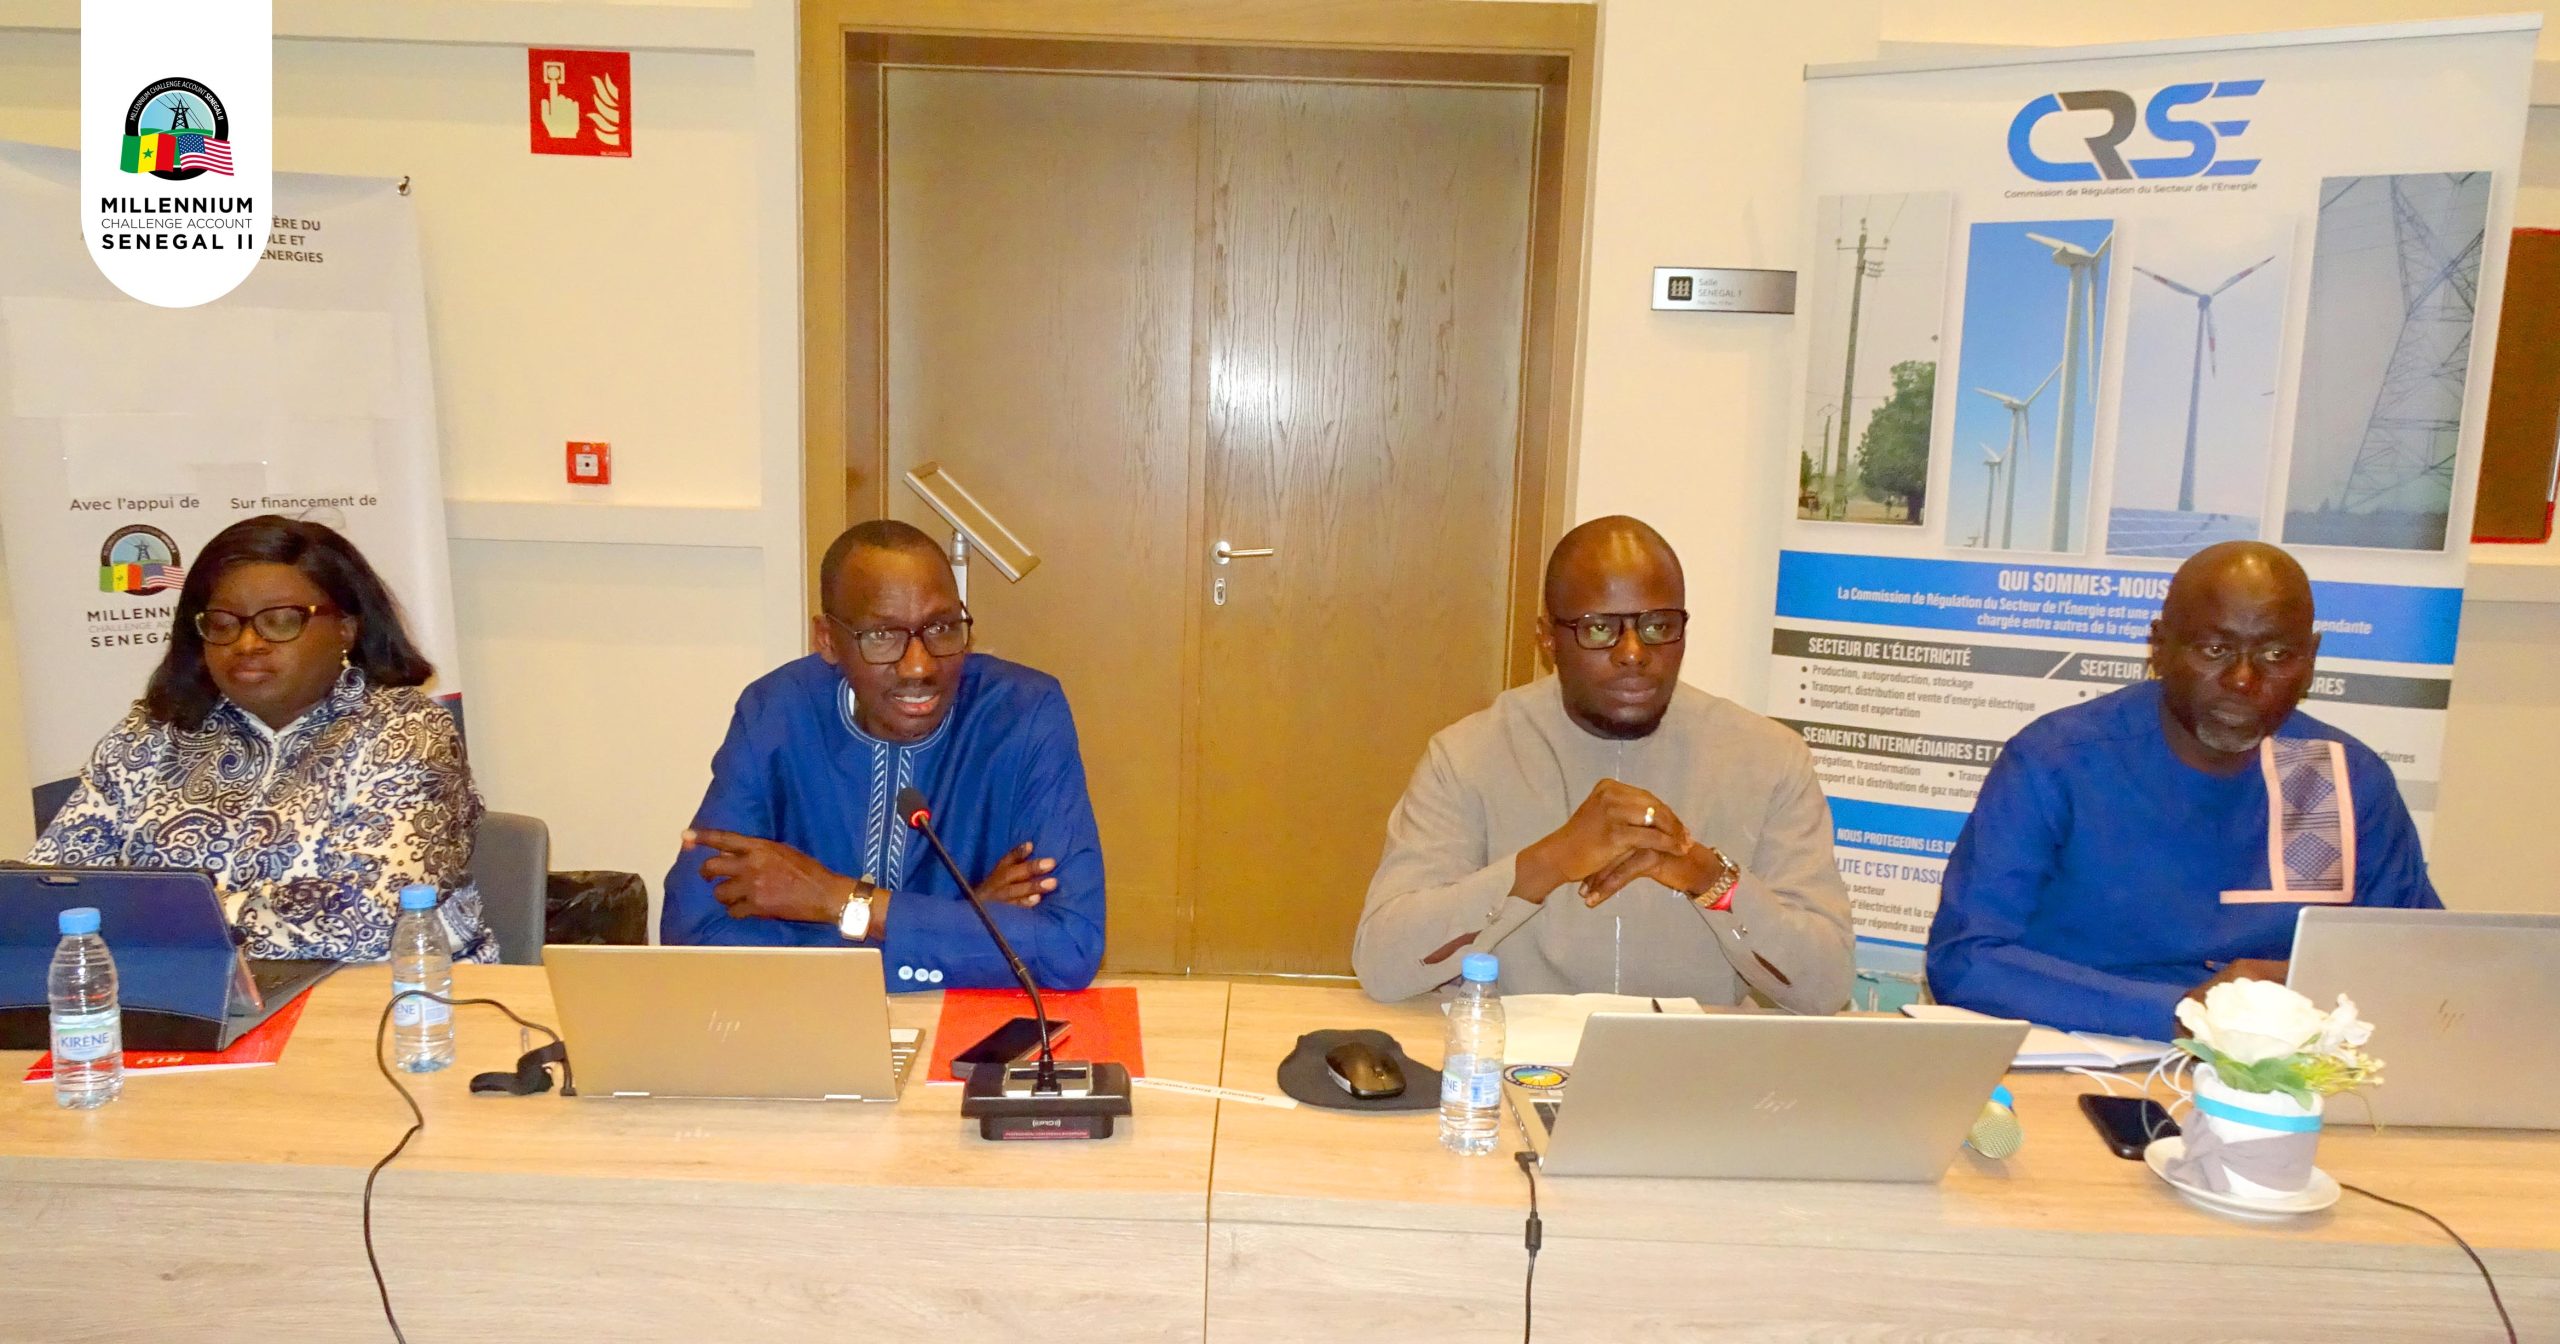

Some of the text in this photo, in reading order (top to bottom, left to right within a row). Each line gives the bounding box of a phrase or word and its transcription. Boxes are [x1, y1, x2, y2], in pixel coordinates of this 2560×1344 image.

[2007, 79, 2266, 183] CRSE
[2004, 188, 2063, 199] Commission
[2065, 187, 2079, 196] de
[2137, 185, 2151, 195] du
[2153, 183, 2193, 194] Secteur
[2195, 182, 2209, 192] de
[301, 219, 321, 231] DU
[267, 233, 305, 246] LE ET
[70, 496, 200, 511] Avec l'appui de
[231, 494, 377, 509] Sur financement de
[1998, 569, 2171, 600] QUI SOMMES-NOUS
[1837, 586, 1850, 600] La
[1850, 587, 1911, 604] Commission
[1912, 592, 1925, 605] de
[1926, 592, 1982, 609] Régulation
[1983, 597, 1998, 610] du
[2000, 597, 2041, 613] Secteur
[2042, 600, 2057, 614] de
[2107, 606, 2126, 618] est
[2127, 608, 2150, 619] une
[1977, 613, 2152, 640] chargée entre autres de la régul
[2312, 619, 2373, 634] pendante
[90, 632, 172, 648] SENEGA
[1808, 636, 1972, 666] SECTEUR DE L'ÉLECTRICITÉ
[1812, 664, 1974, 691] Production, autoproduction, stockage
[2080, 658, 2144, 680] SECTEUR
[1855, 686, 1905, 701] distribution
[1906, 690, 1916, 701] et
[1917, 692, 1942, 704] vente
[1810, 696, 1921, 719] Importation et exportation
[1802, 726, 1867, 749] SEGMENTS
[1867, 733, 1974, 760] INTERMÉDIAIRES
[1975, 745, 1993, 762] ET
[1813, 755, 1921, 777] grégation, transformation
[1958, 769, 1986, 782] Trans
[1847, 775, 1856, 785] et
[1856, 774, 1865, 786] la
[1865, 776, 1917, 792] distribution
[1918, 782, 1930, 793] de
[1930, 785, 1947, 797] gaz
[1948, 787, 1978, 799] nature
[1836, 828, 1863, 842] NOUS
[1925, 839, 1944, 853] LES
[1837, 857, 1943, 885] LITE C'EST D'ASSU
[1852, 883, 1886, 896] secteur
[1903, 906, 1913, 917] et
[1914, 906, 1922, 918] la
[1868, 916, 1908, 932] répondre
[1909, 924, 1926, 934] aux
[60, 1031, 109, 1048] KIRENE
